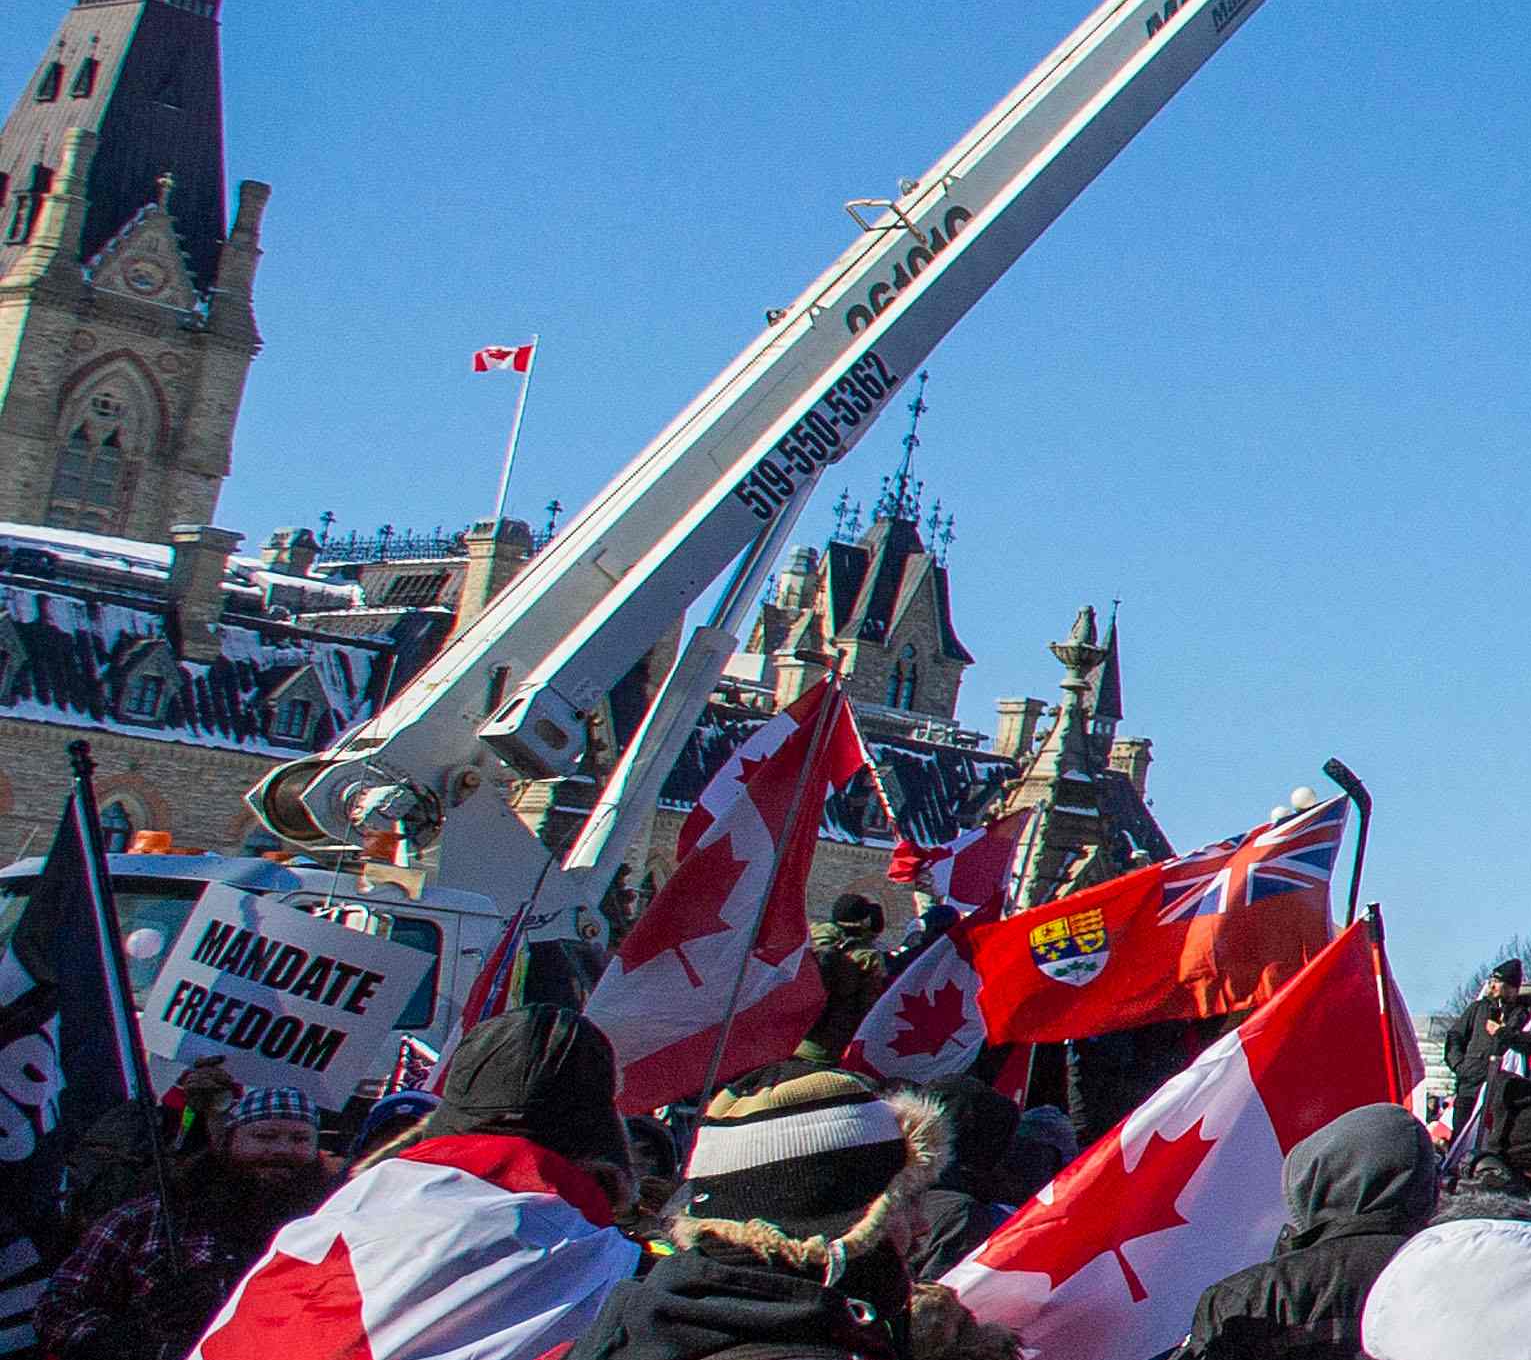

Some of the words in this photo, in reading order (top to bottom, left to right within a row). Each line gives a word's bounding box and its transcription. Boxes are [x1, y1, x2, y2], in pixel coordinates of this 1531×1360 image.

[735, 351, 900, 520] 519-550-5362
[191, 919, 385, 1015] MANDATE
[162, 979, 348, 1071] FREEDOM
